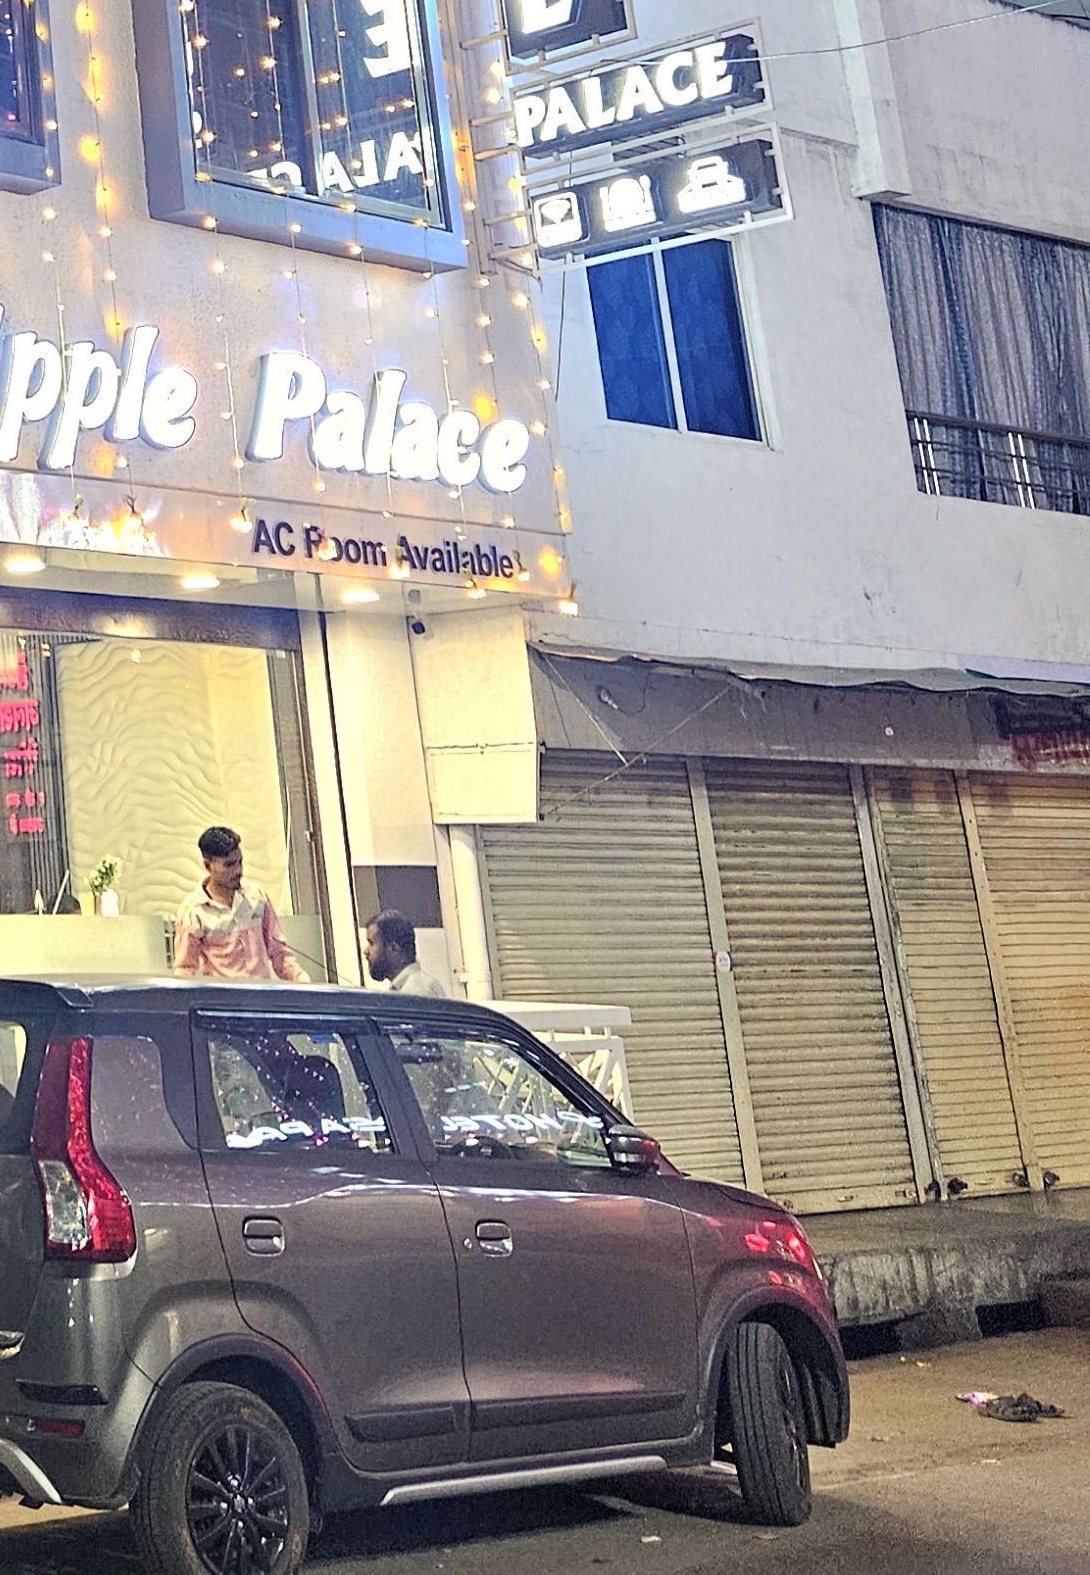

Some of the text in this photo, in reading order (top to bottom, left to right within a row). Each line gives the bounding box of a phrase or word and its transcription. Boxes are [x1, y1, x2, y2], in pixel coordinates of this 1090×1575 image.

[514, 41, 735, 148] PALACE
[246, 351, 528, 493] Palace
[253, 519, 296, 556] AC
[397, 535, 514, 578] Available
